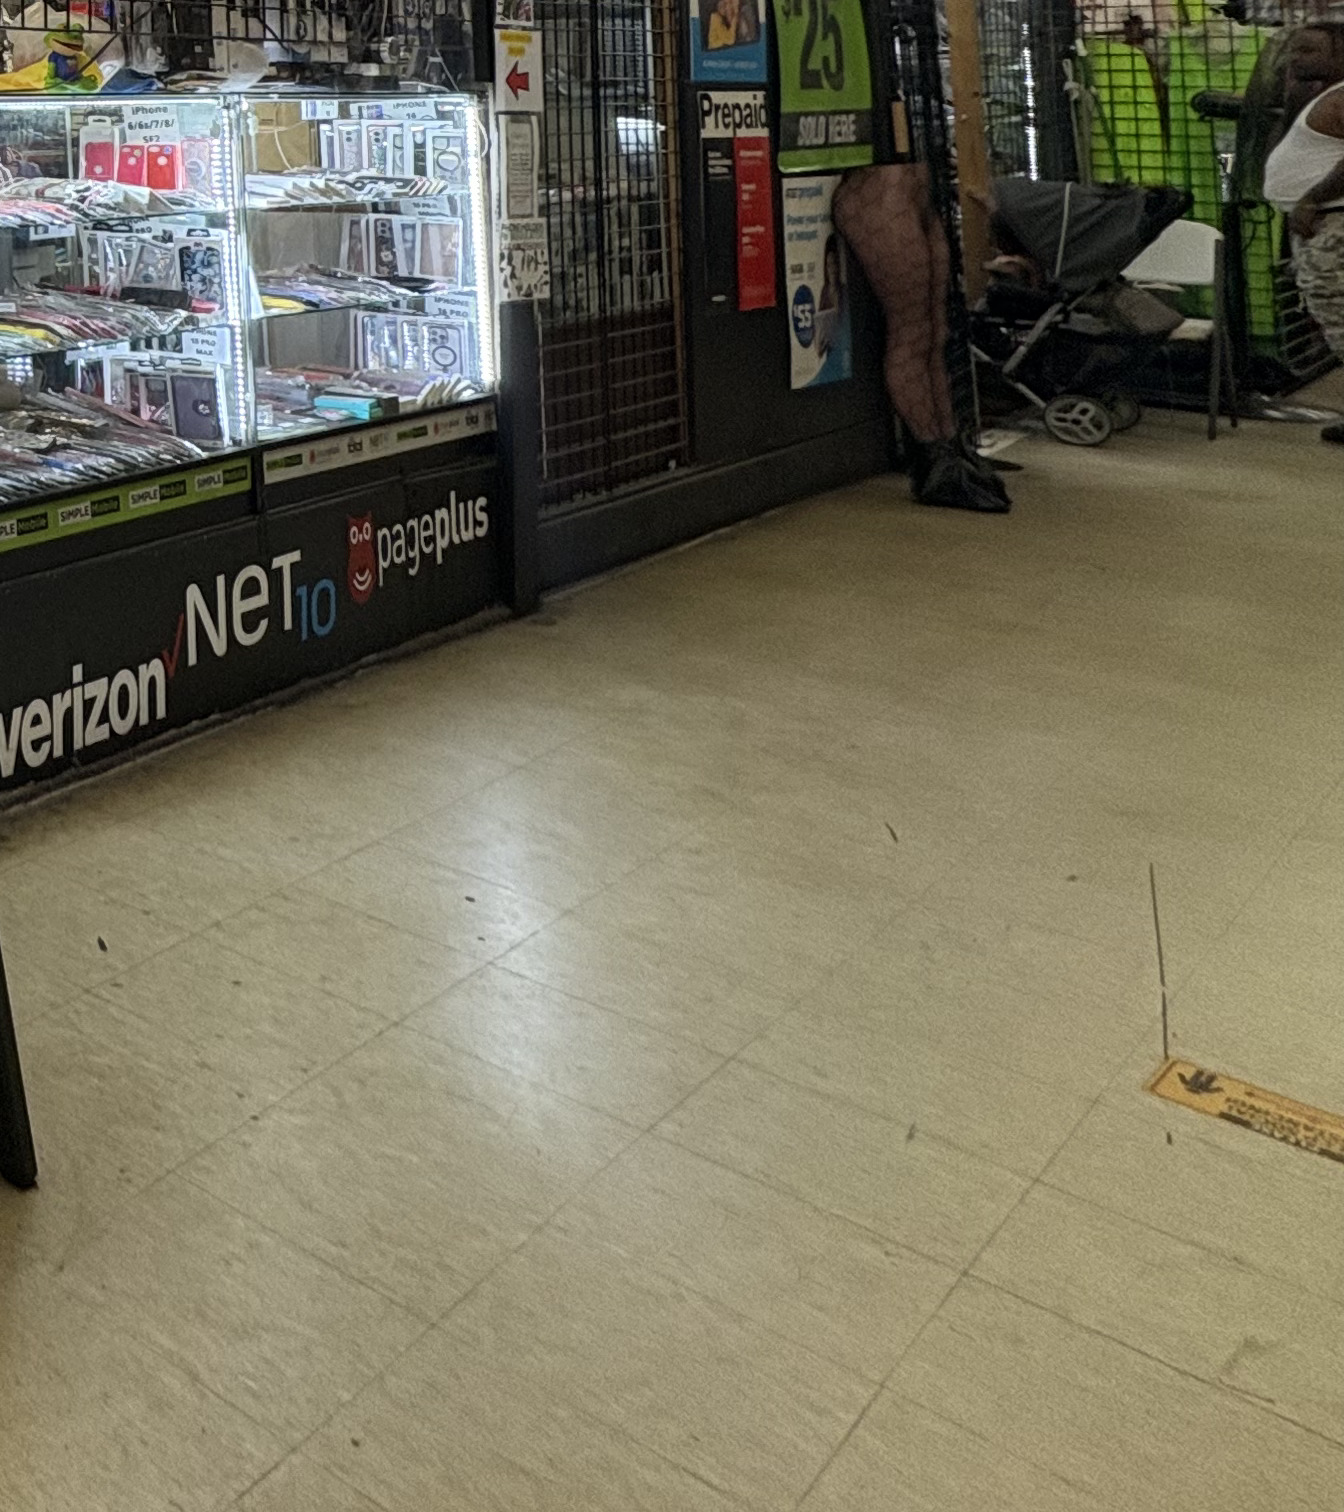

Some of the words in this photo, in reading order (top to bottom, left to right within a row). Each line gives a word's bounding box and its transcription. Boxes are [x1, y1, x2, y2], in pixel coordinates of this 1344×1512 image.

[698, 92, 770, 138] Prepaid
[60, 504, 91, 522] SIMPLE
[376, 490, 491, 586] pageplus
